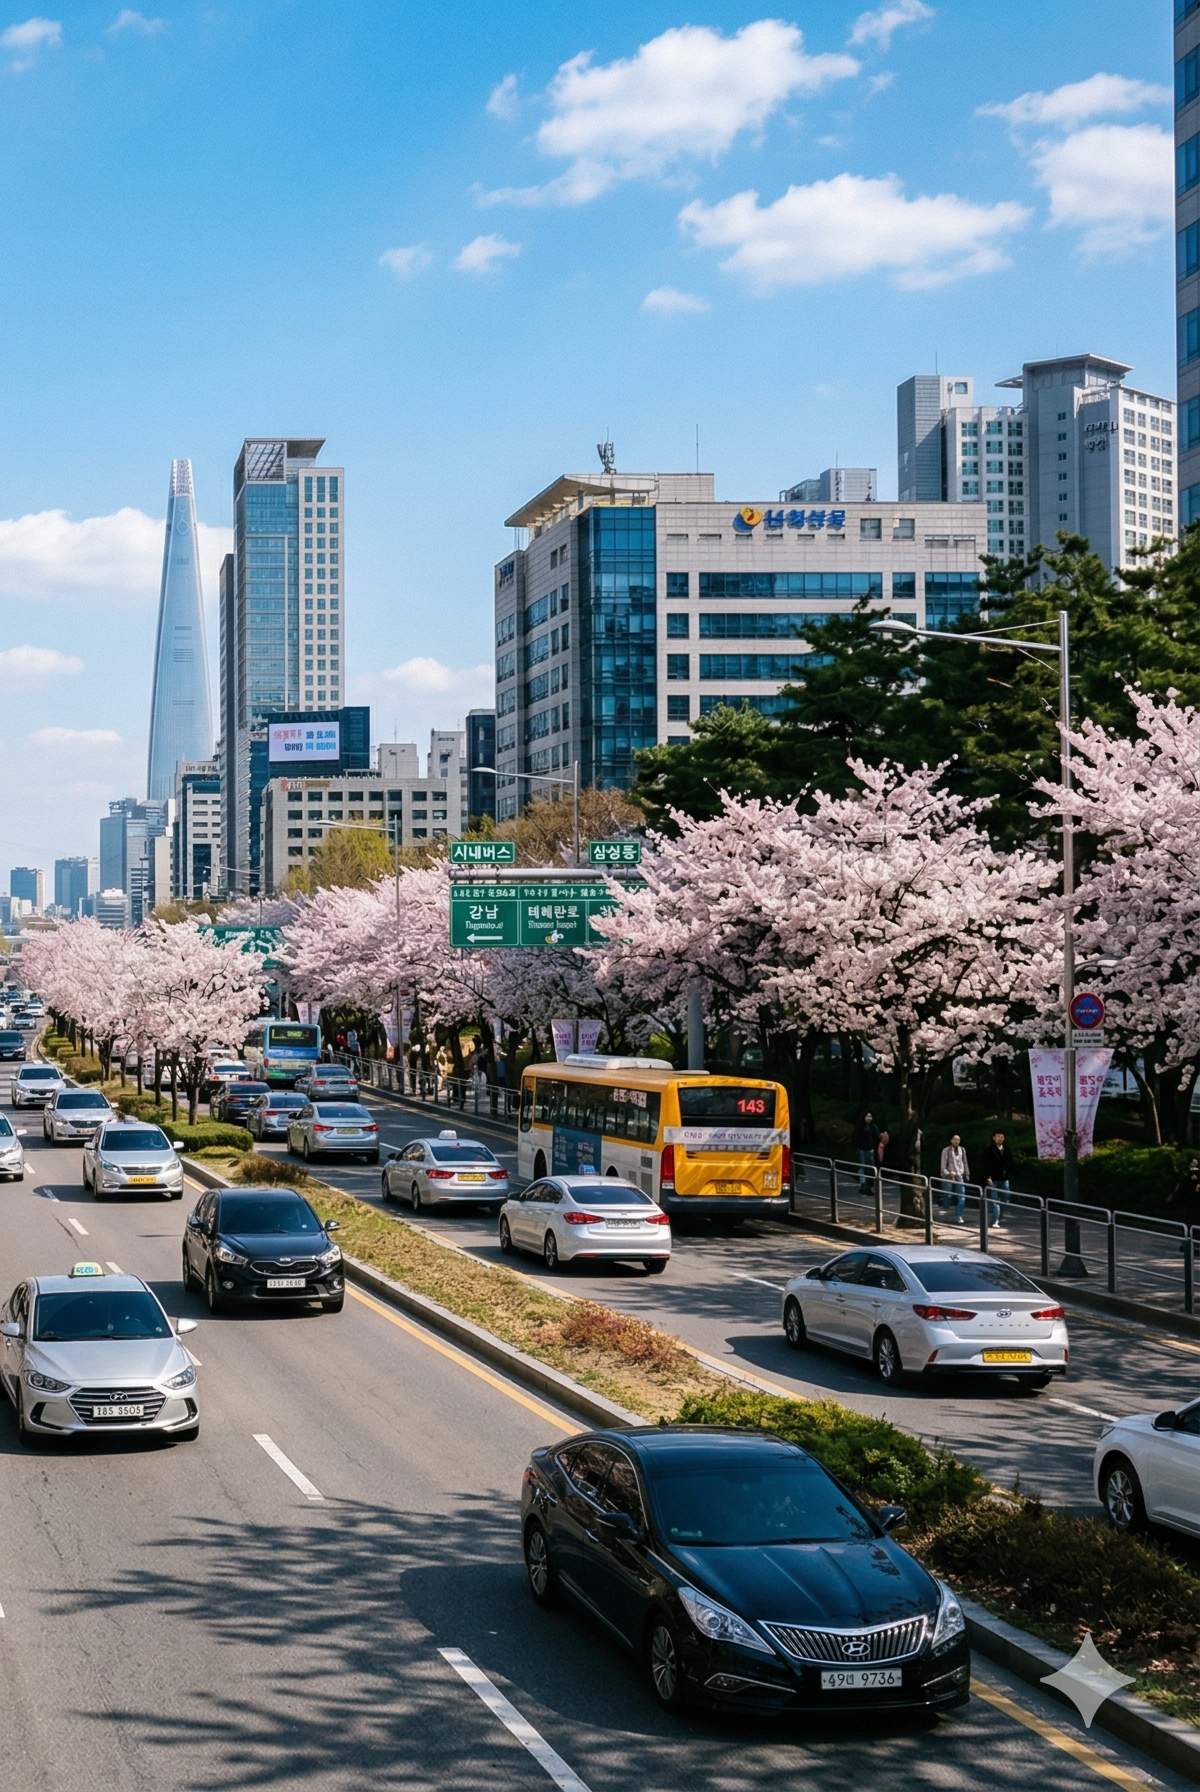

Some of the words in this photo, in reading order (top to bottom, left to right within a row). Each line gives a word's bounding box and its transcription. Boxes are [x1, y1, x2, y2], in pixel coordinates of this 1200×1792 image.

[453, 844, 511, 861] 시내버스
[469, 904, 499, 920] 강남
[737, 1098, 765, 1114] 143
[861, 1671, 895, 1687] 9736
